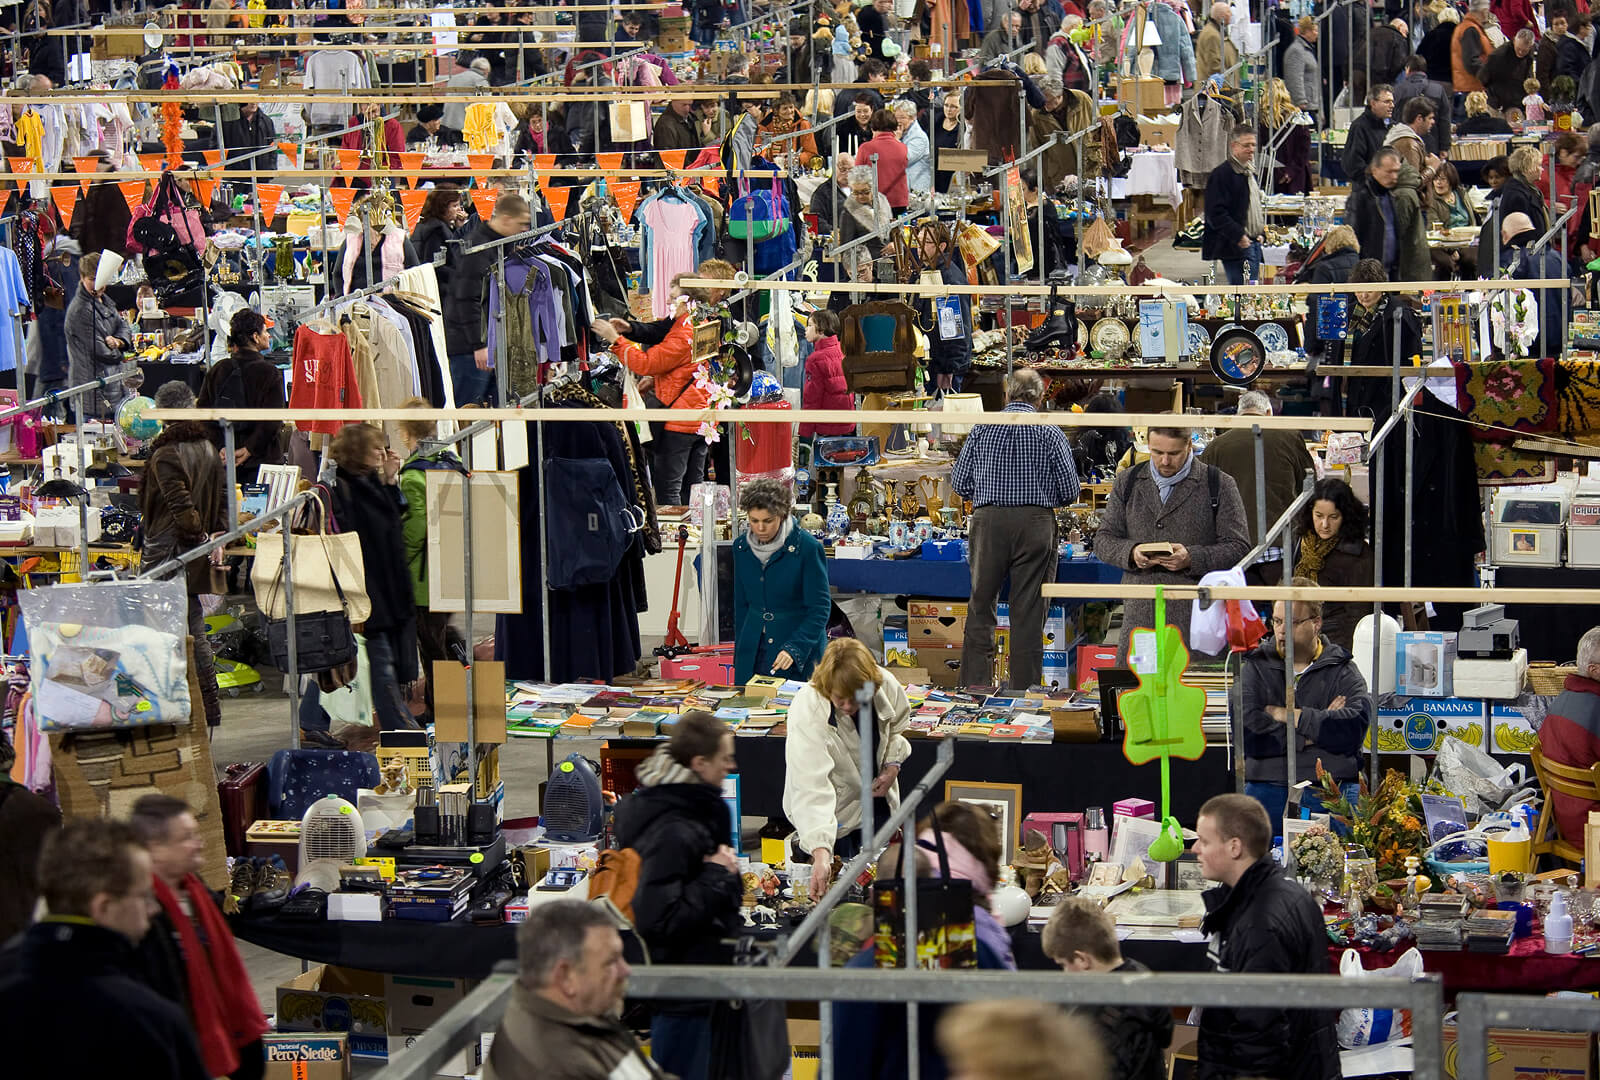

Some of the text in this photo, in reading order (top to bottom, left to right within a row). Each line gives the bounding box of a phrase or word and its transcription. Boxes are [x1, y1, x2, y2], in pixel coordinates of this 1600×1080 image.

[1575, 507, 1600, 515] CHUC
[910, 604, 939, 616] Dole
[1423, 703, 1474, 712] BANANAS
[1407, 731, 1433, 741] Chiquita
[268, 1045, 337, 1061] Percy Sledge
